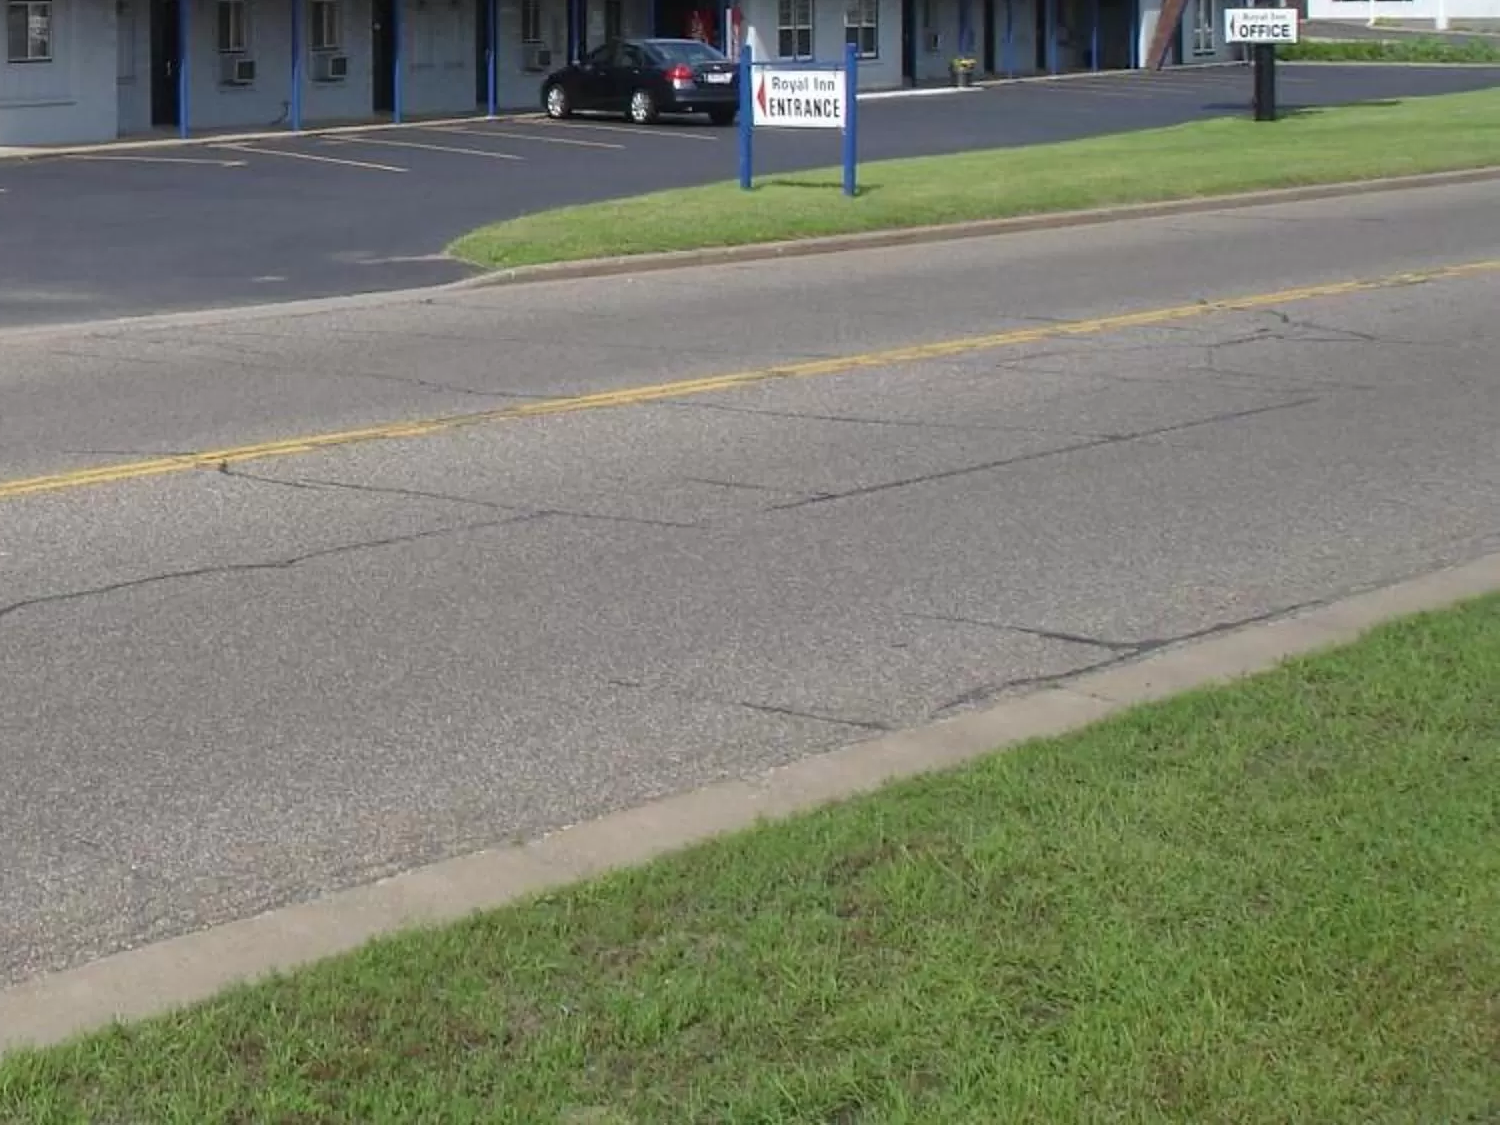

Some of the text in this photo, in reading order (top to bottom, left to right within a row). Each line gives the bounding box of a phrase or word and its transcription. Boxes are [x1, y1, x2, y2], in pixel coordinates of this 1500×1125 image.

[1242, 12, 1268, 22] Royal
[1239, 24, 1291, 38] OFFICE
[771, 76, 836, 94] Royal Inn
[768, 98, 841, 118] ENTRANCE
